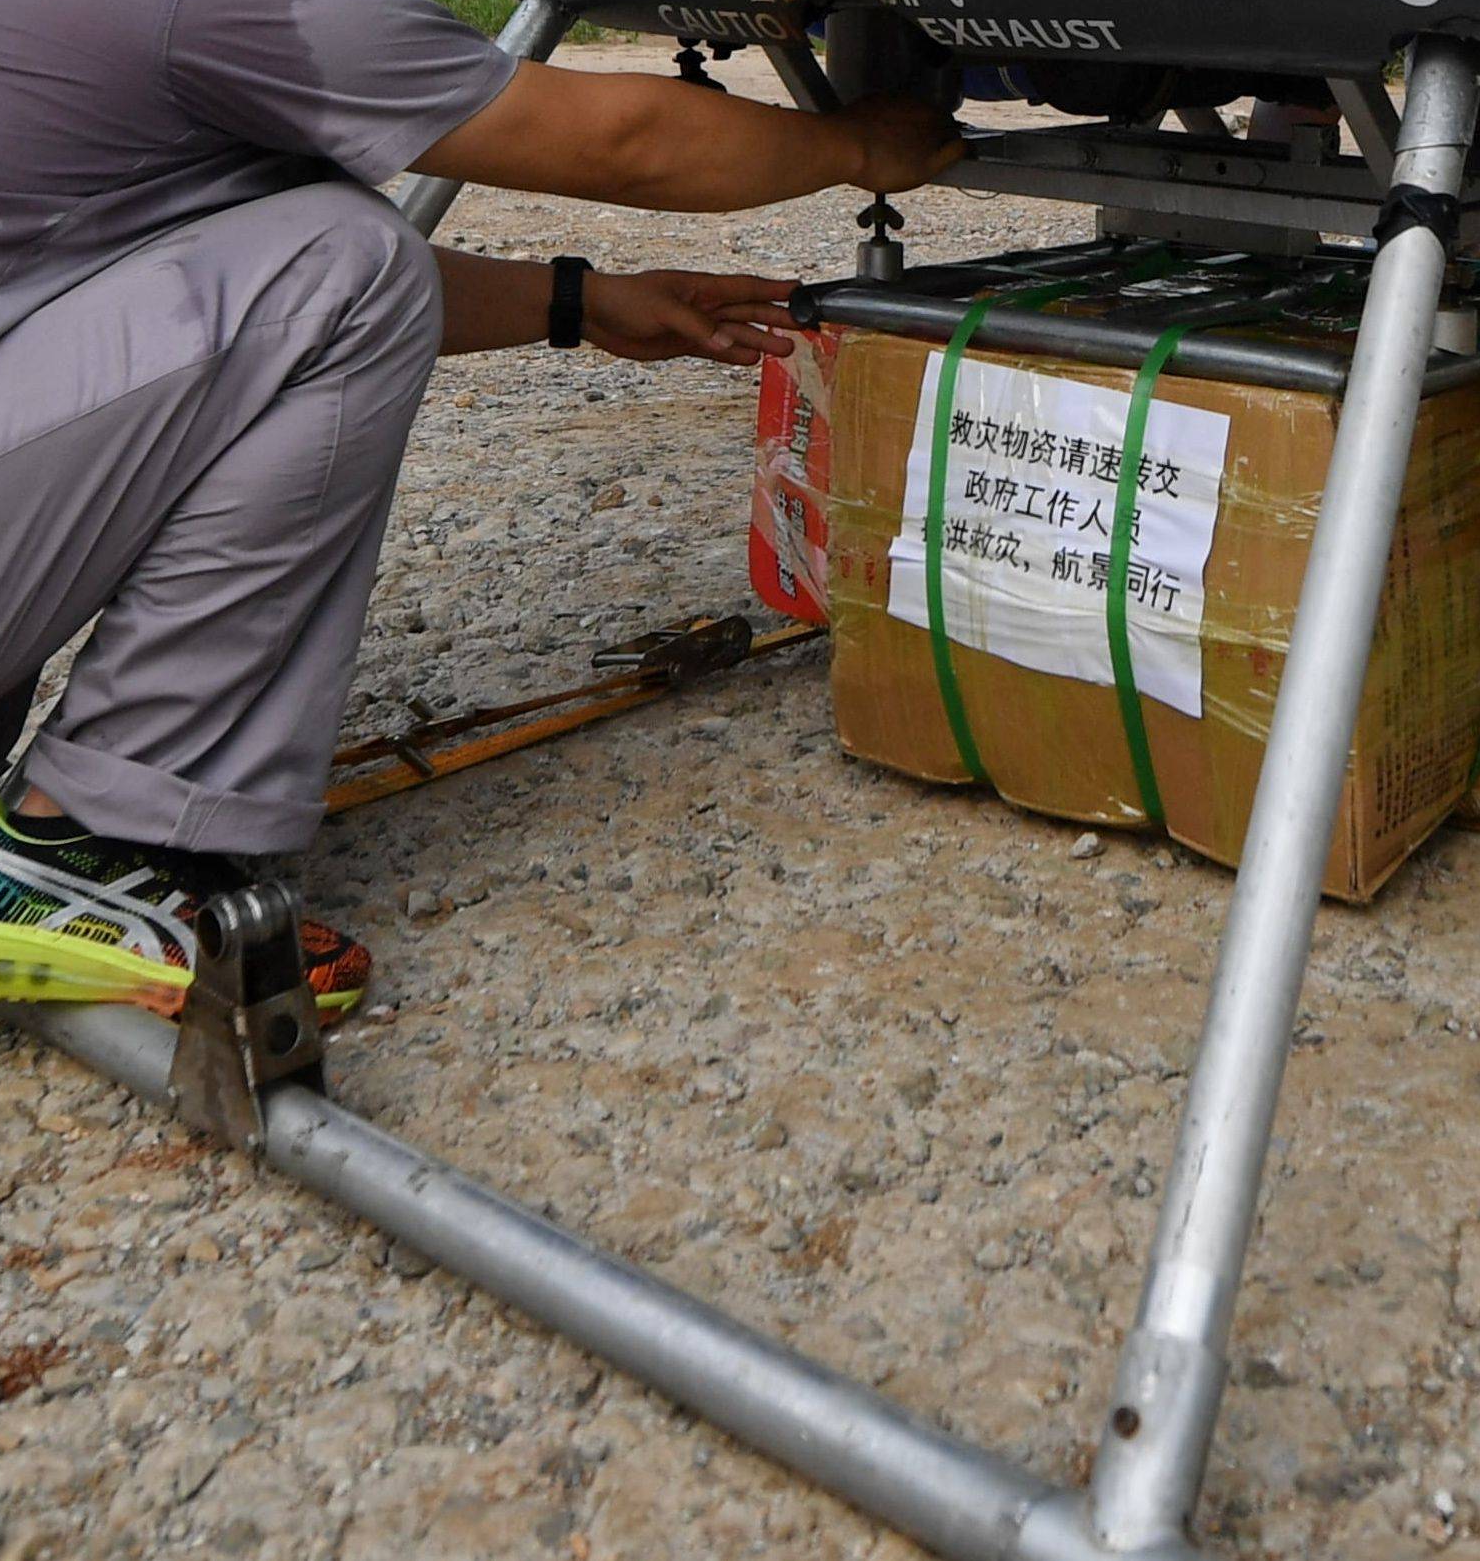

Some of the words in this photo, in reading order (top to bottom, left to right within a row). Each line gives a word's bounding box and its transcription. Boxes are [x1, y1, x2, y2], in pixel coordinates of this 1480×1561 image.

[657, 4, 793, 41] CAUTIO
[917, 17, 1122, 51] EXHAUST
[920, 515, 1181, 612] 洪救灾，航景同行
